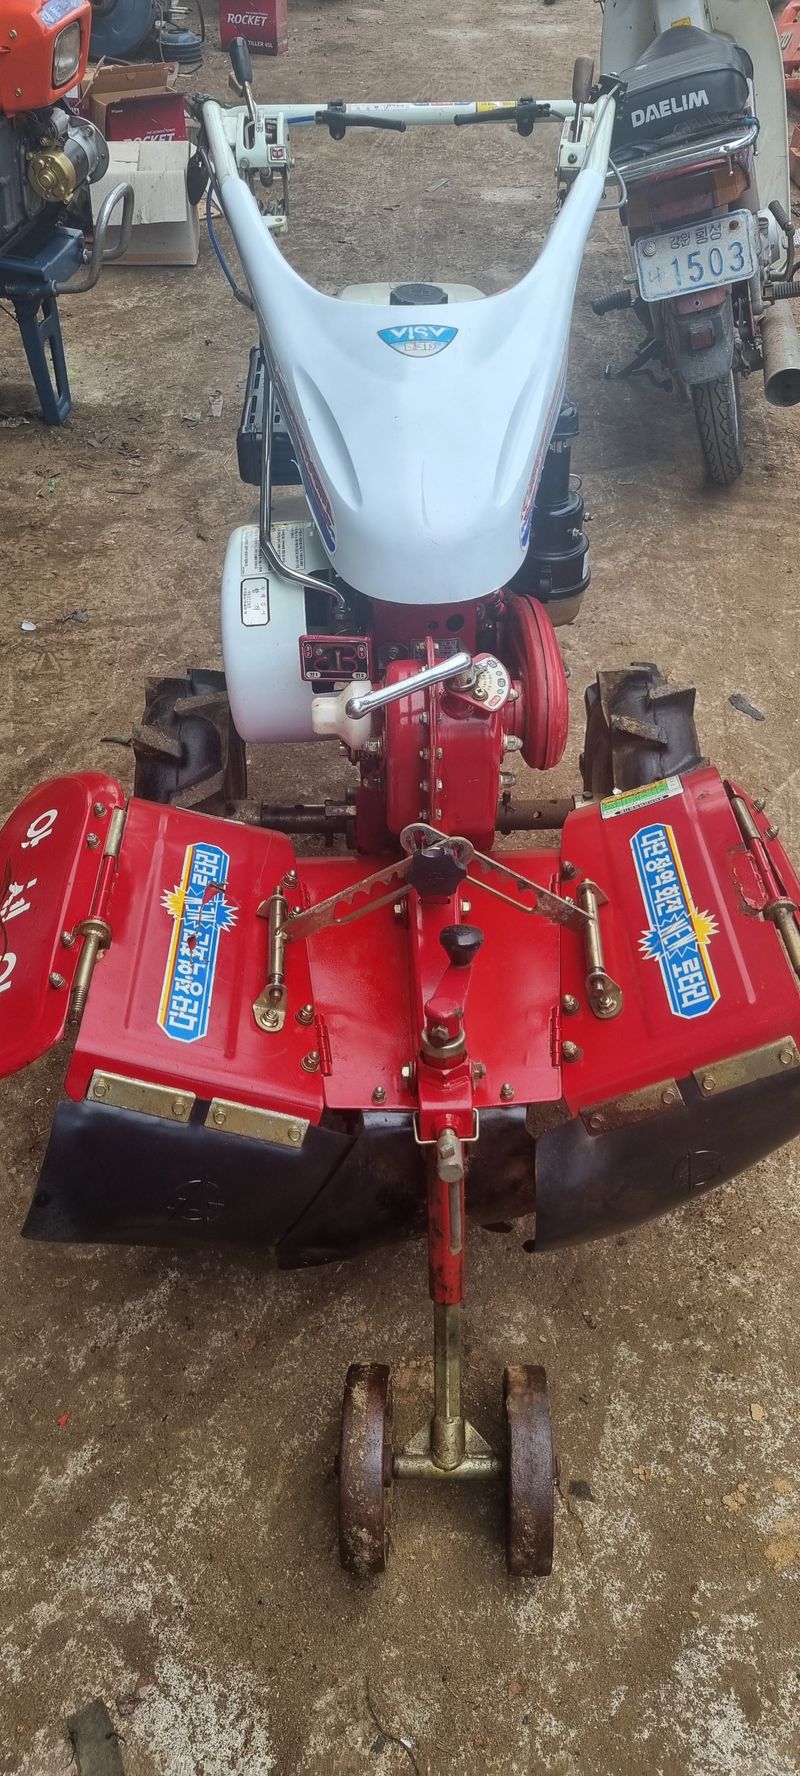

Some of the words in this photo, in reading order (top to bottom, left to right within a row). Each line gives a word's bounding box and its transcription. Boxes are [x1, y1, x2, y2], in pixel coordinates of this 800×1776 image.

[227, 13, 268, 27] ROCKET
[631, 89, 709, 128] DAELIM
[670, 233, 691, 249] 강원
[695, 224, 722, 245] 횡성
[672, 241, 745, 286] 1503
[658, 919, 697, 951] NEW
[672, 957, 710, 1008] 로타리
